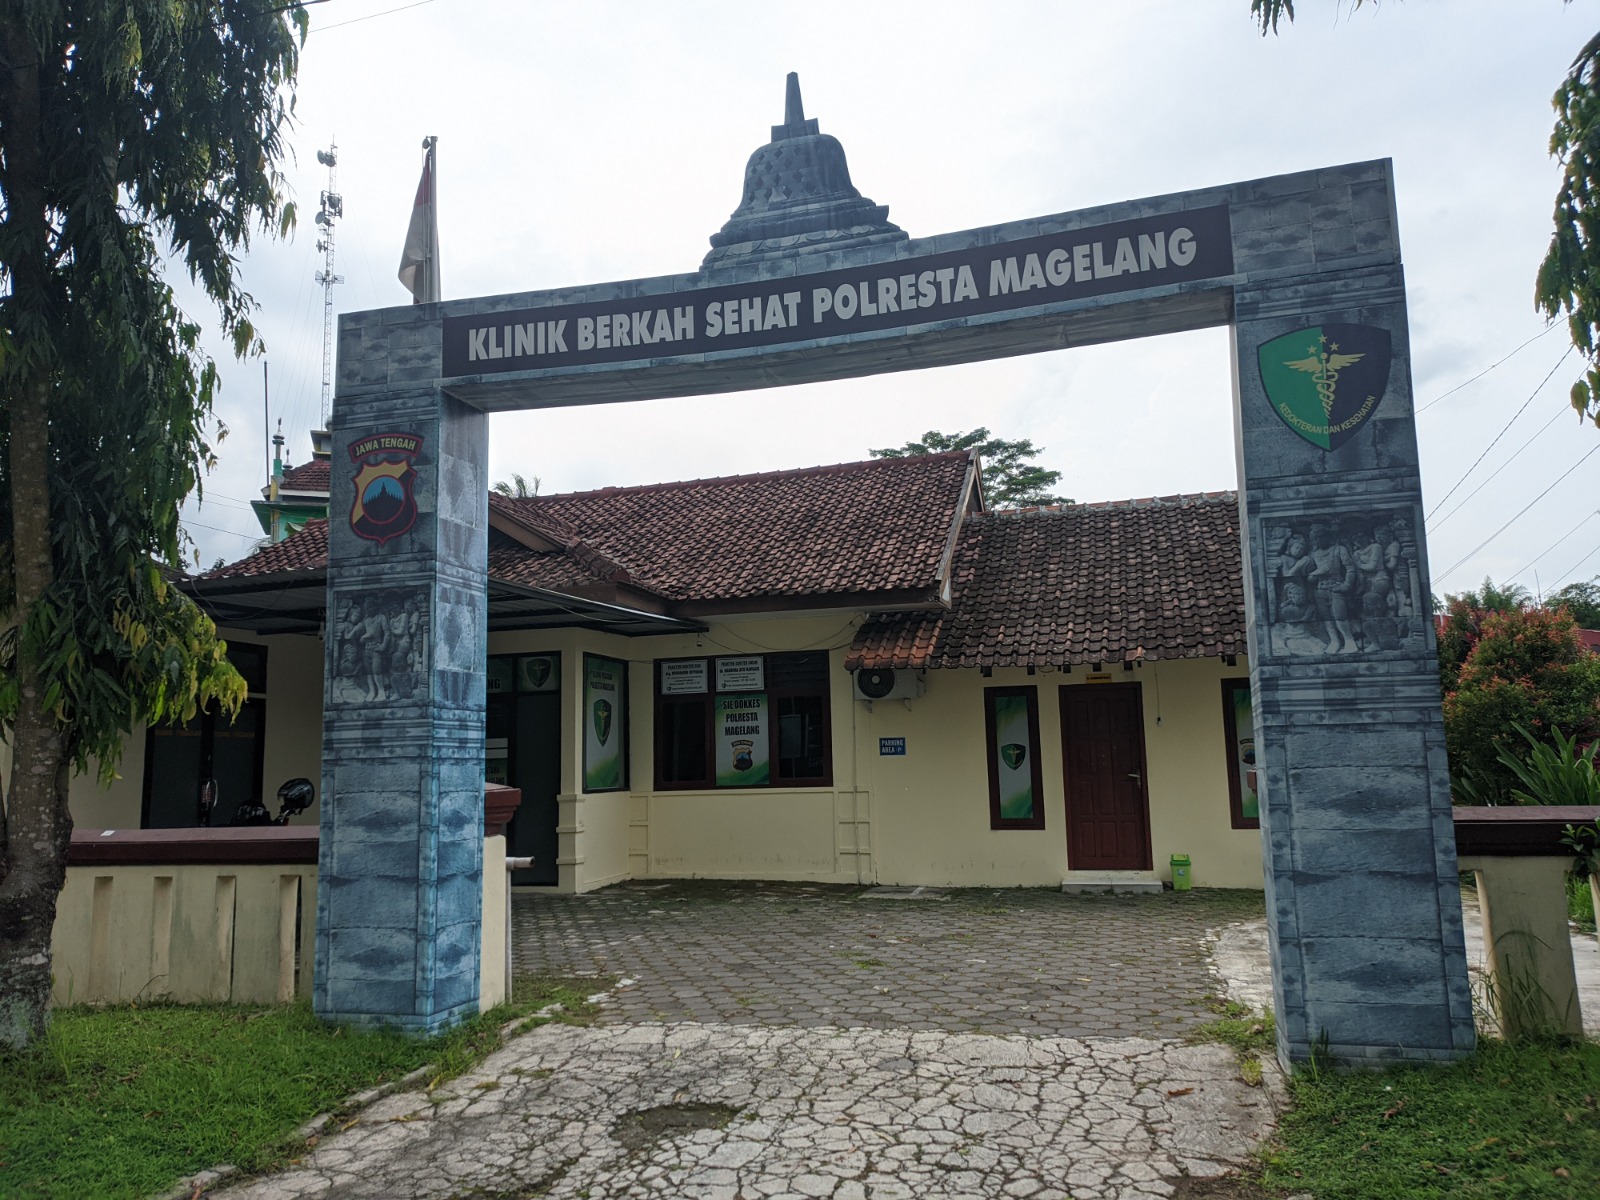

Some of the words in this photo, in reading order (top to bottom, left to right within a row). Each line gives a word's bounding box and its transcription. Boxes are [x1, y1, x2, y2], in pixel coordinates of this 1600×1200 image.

[468, 318, 569, 362] KLINIK
[577, 305, 695, 351] BERKAH
[705, 290, 801, 338] SEHAT
[812, 264, 980, 323] POLRESTA
[988, 227, 1198, 297] MAGELANG
[1278, 402, 1322, 434] KEDOKTERAN
[1323, 425, 1341, 434] DAN
[1341, 395, 1376, 431] KESEHATAN
[355, 440, 379, 456] JAWA
[380, 437, 416, 451] TENGAH
[723, 700, 733, 710] SIE
[734, 698, 760, 709] DOKKES
[726, 712, 758, 723] POLRESTA
[725, 725, 760, 736] MAGELANG
